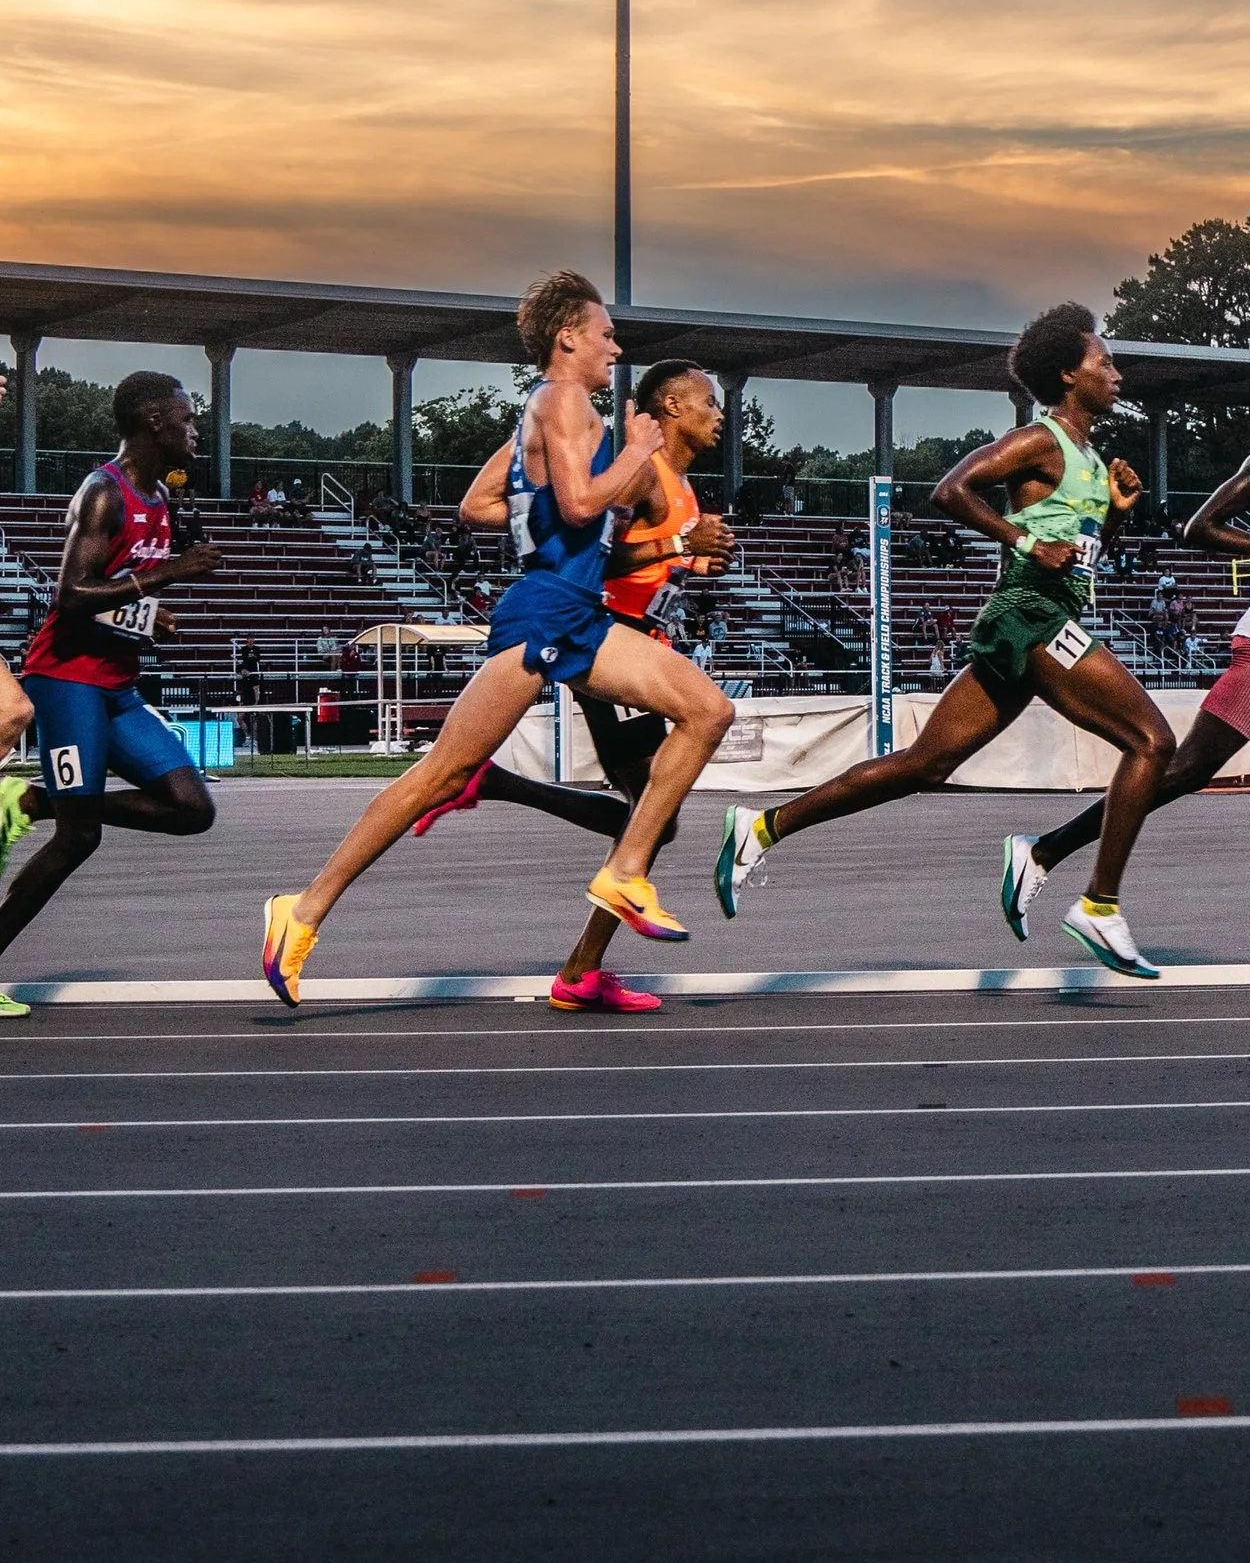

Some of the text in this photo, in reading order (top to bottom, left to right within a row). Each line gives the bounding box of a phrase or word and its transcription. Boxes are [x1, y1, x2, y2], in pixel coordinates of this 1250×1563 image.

[880, 538, 891, 724] NCAA TRACK & FIELD CHAMPIONSHIPS
[1055, 628, 1086, 659] 11
[57, 749, 74, 786] 6
